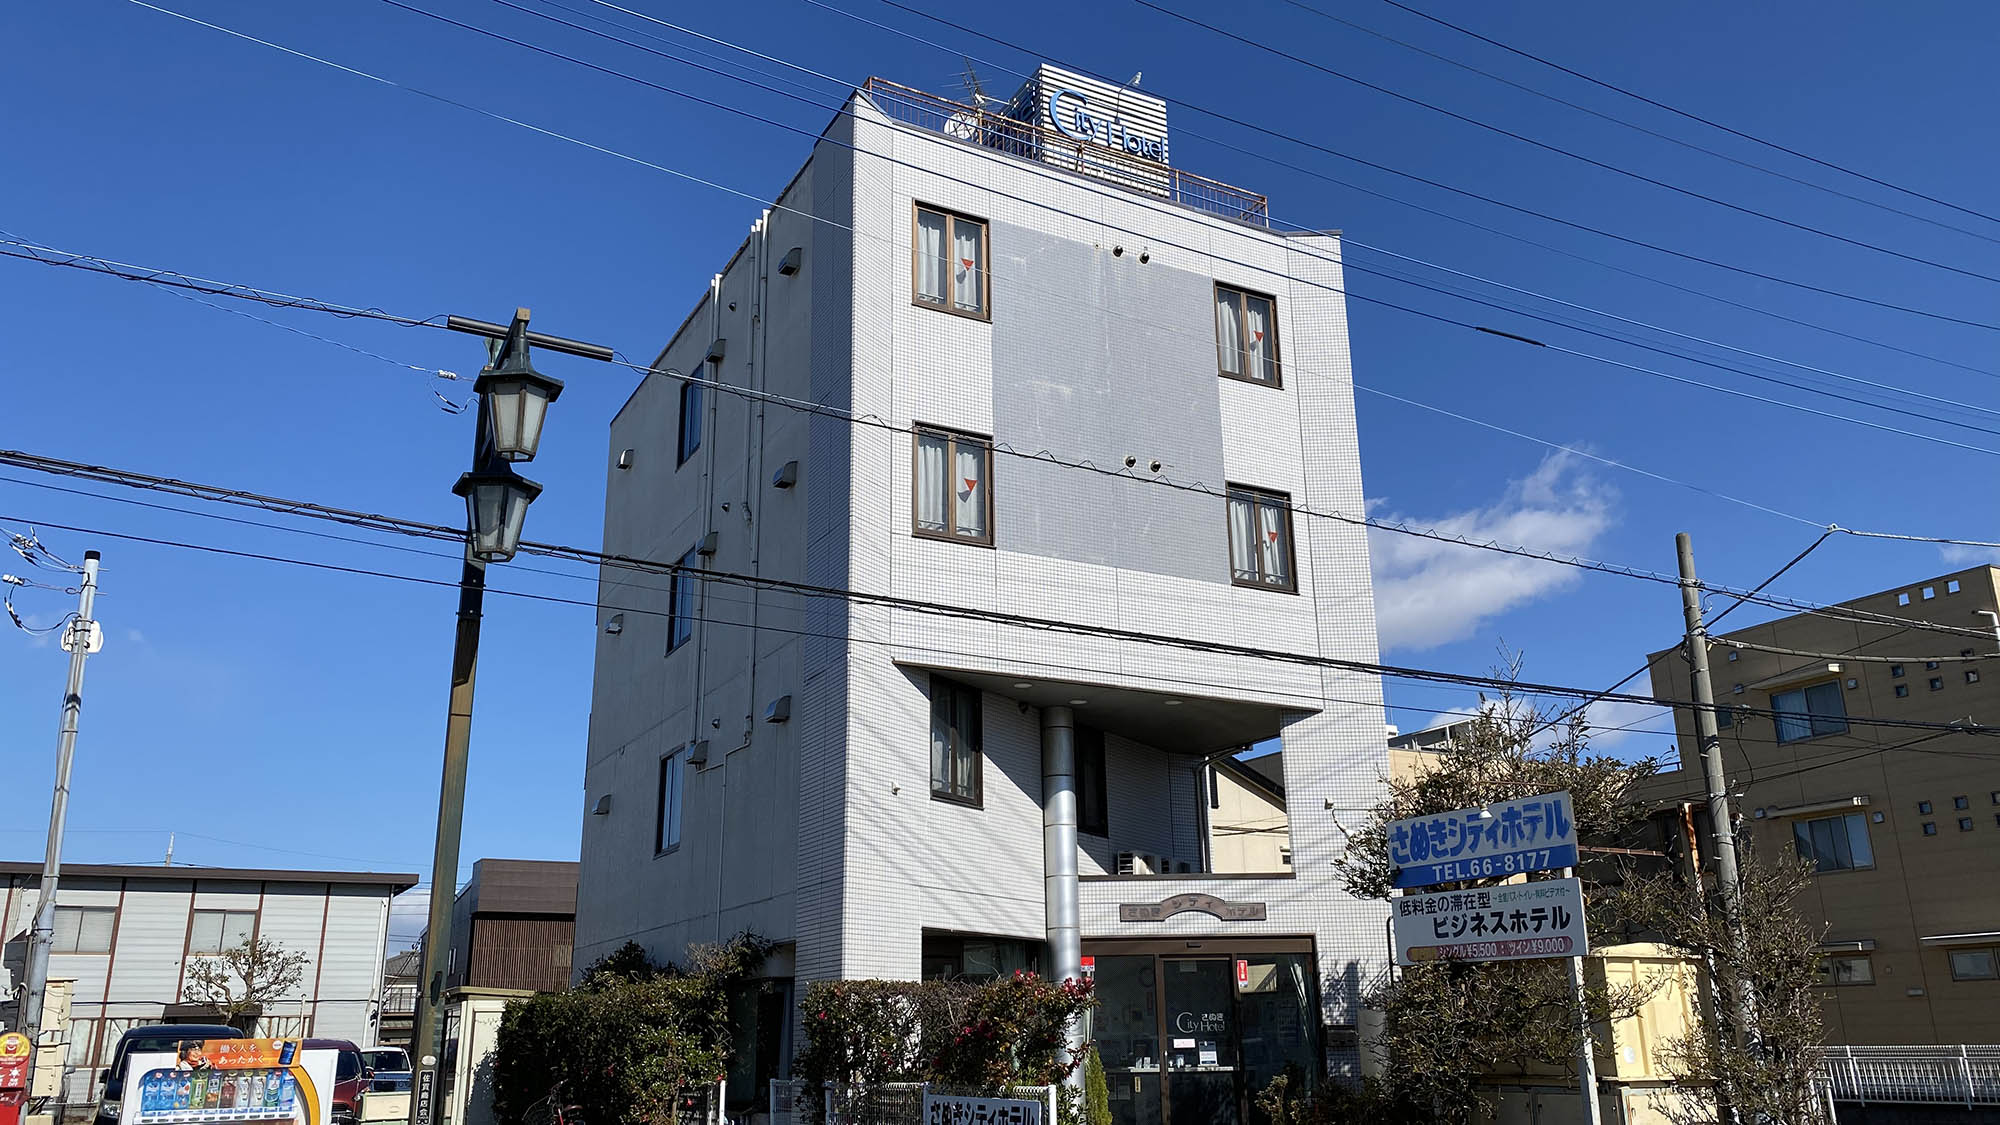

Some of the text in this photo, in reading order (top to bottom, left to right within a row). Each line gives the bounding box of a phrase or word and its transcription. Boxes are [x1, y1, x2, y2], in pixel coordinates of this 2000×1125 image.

[1049, 88, 1101, 142] City
[1107, 120, 1166, 162] Hotel
[1390, 800, 1572, 865] さぬきシティホテル
[1432, 850, 1551, 881] TEL.66-8177
[1400, 891, 1492, 918] 低料金の滞在型
[1433, 906, 1571, 939] ビジネスホテル
[1176, 1011, 1225, 1033] City Hotel
[218, 1055, 264, 1065] あったかく
